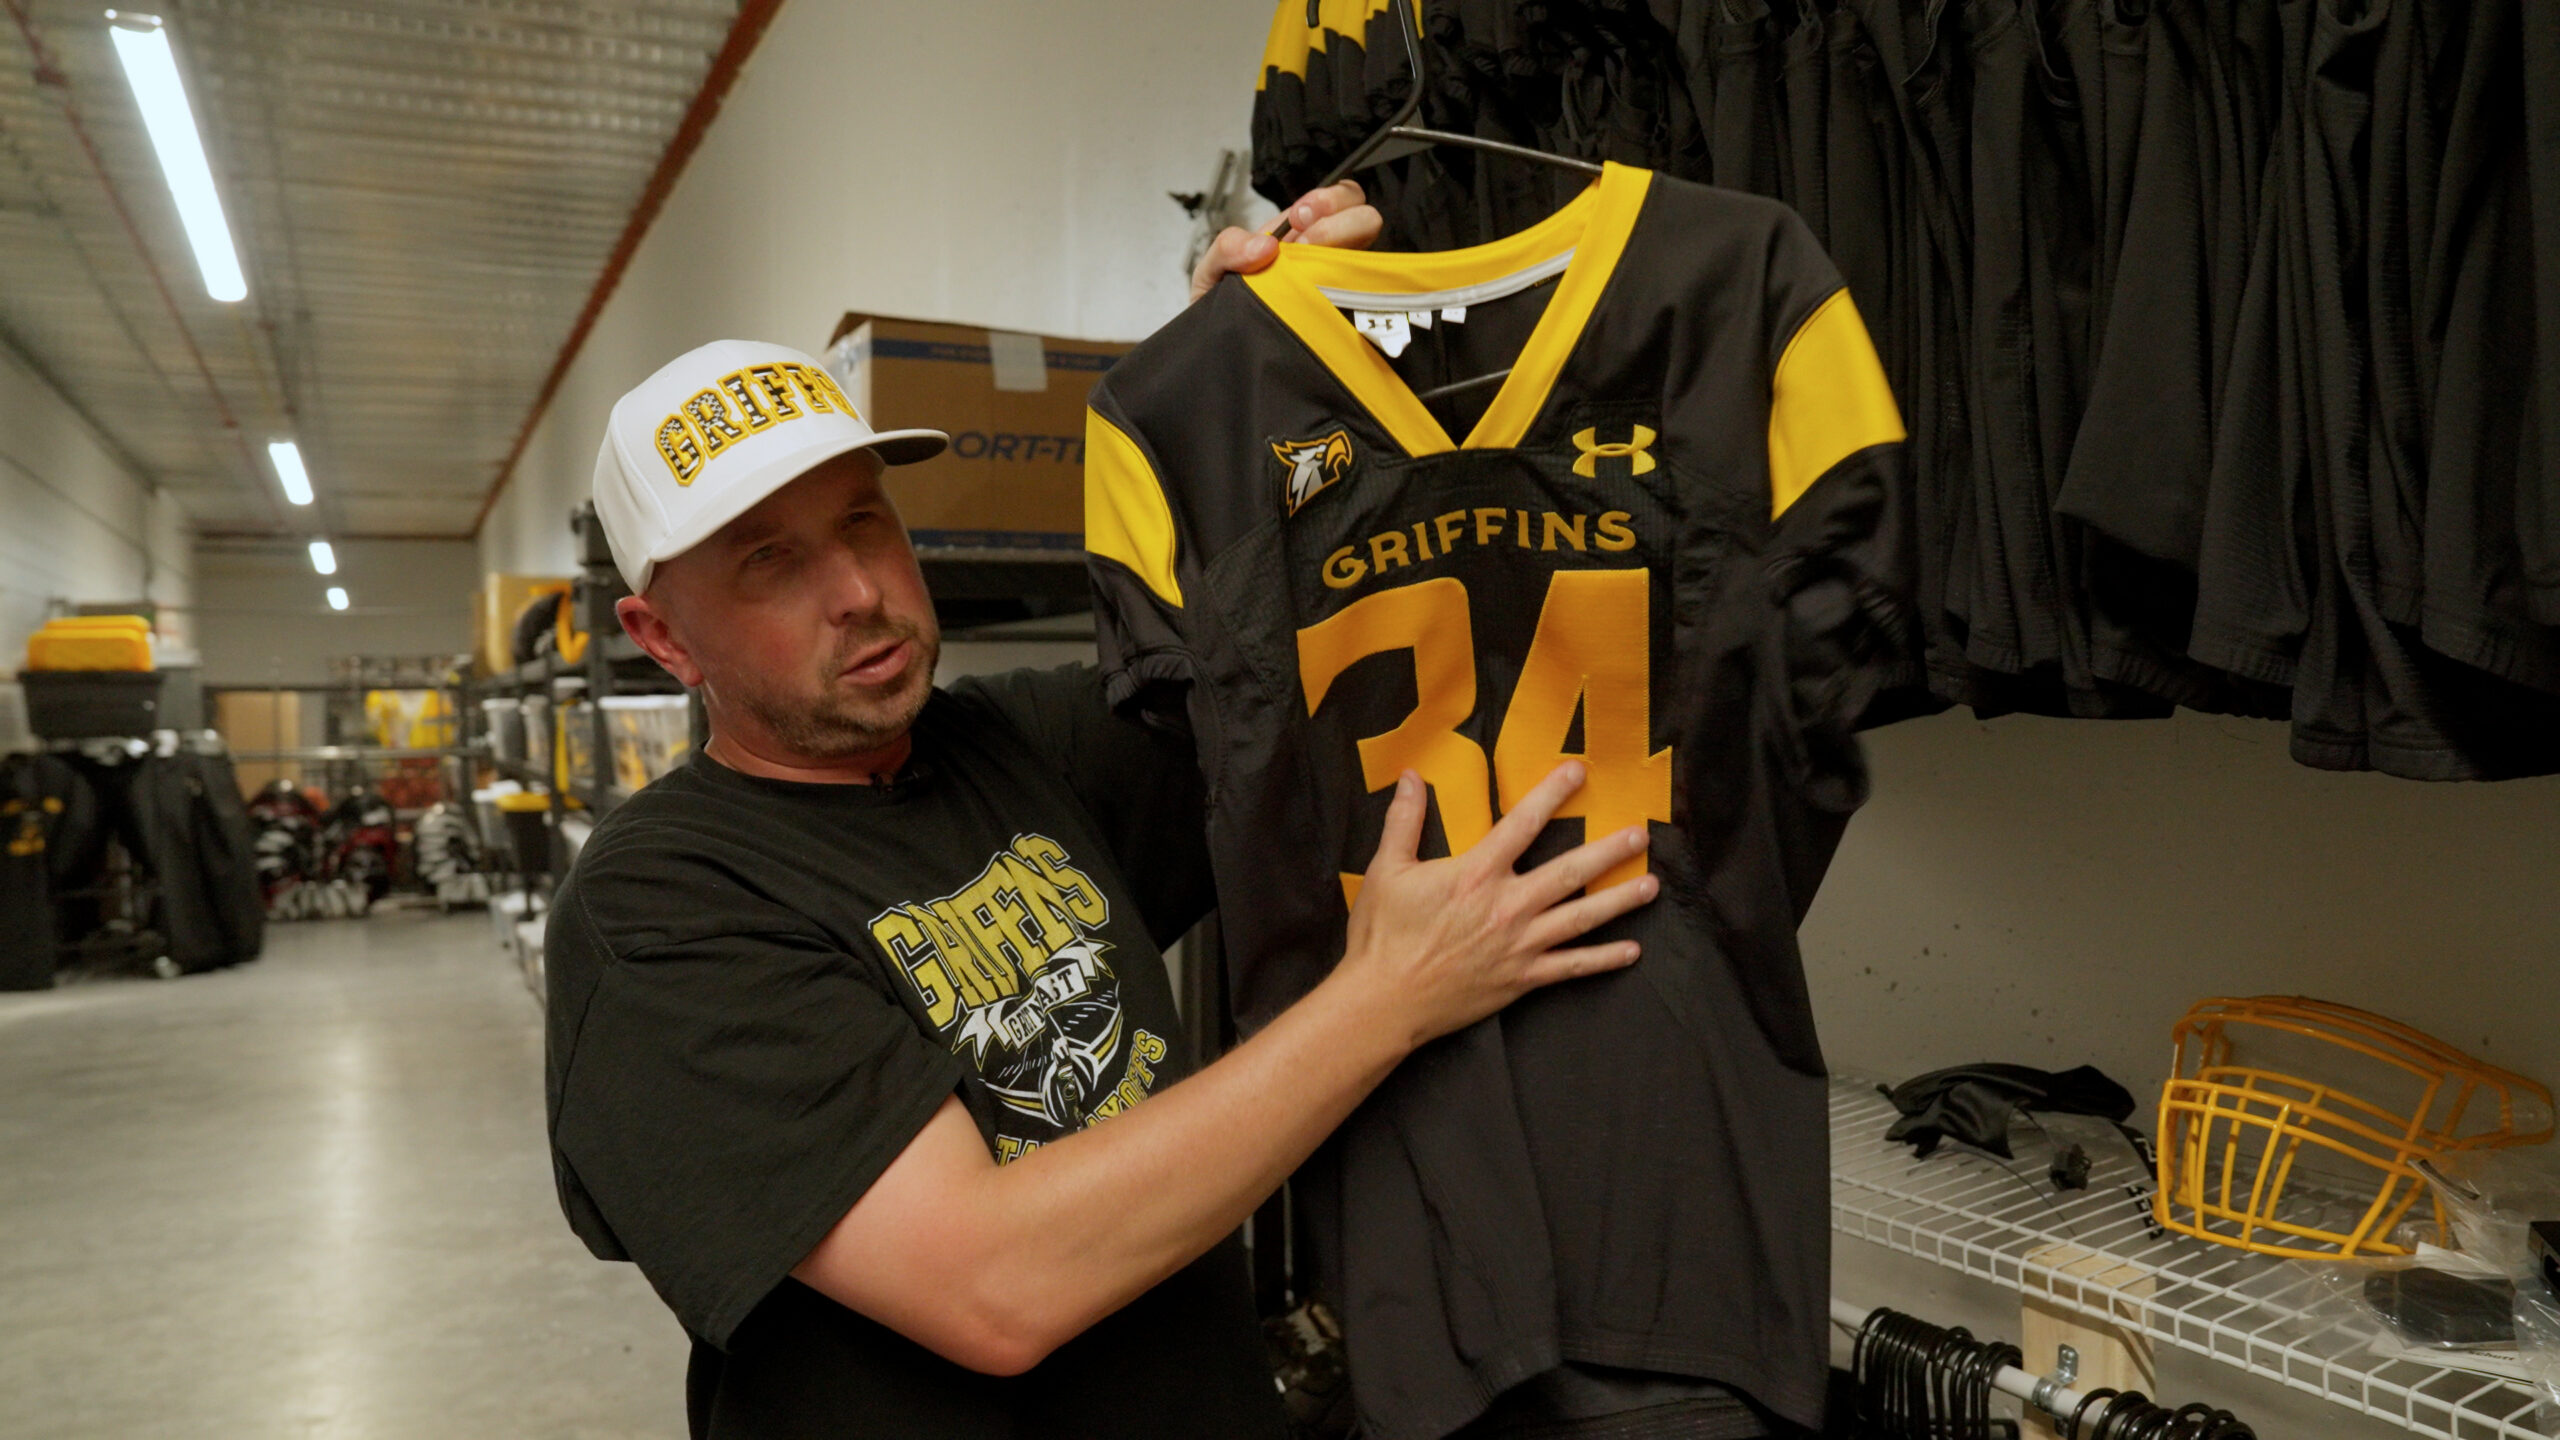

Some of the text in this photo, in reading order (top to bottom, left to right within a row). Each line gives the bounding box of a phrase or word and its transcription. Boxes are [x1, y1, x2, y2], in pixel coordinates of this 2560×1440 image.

[655, 361, 859, 487] GRIFF
[954, 431, 1085, 465] ORT-T
[1322, 508, 1637, 589] GRIFFINS
[1297, 567, 1673, 914] 34
[868, 833, 1109, 1032] GRIFFNS
[1036, 968, 1075, 1008] AST
[1083, 1028, 1167, 1127] YOFFS
